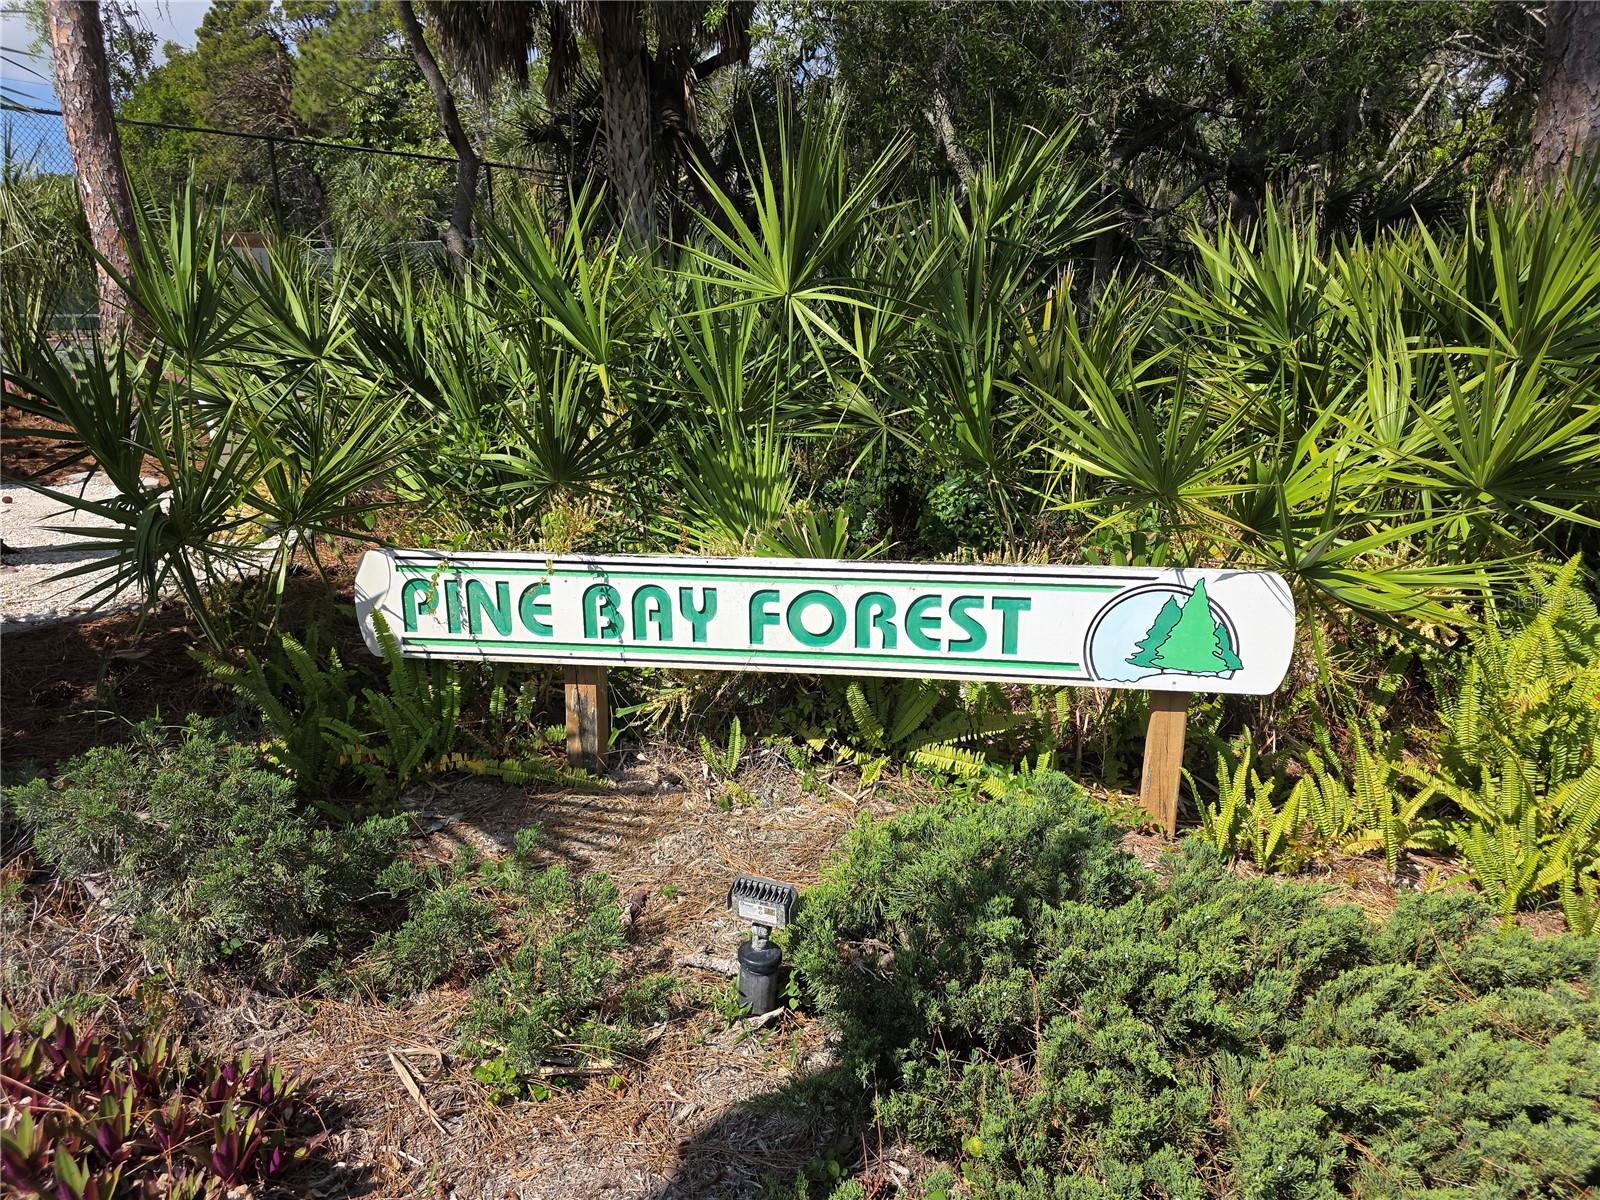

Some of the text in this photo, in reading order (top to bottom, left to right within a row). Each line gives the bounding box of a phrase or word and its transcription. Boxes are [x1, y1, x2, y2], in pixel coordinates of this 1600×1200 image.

[401, 578, 1032, 655] PINE BAY FOREST
